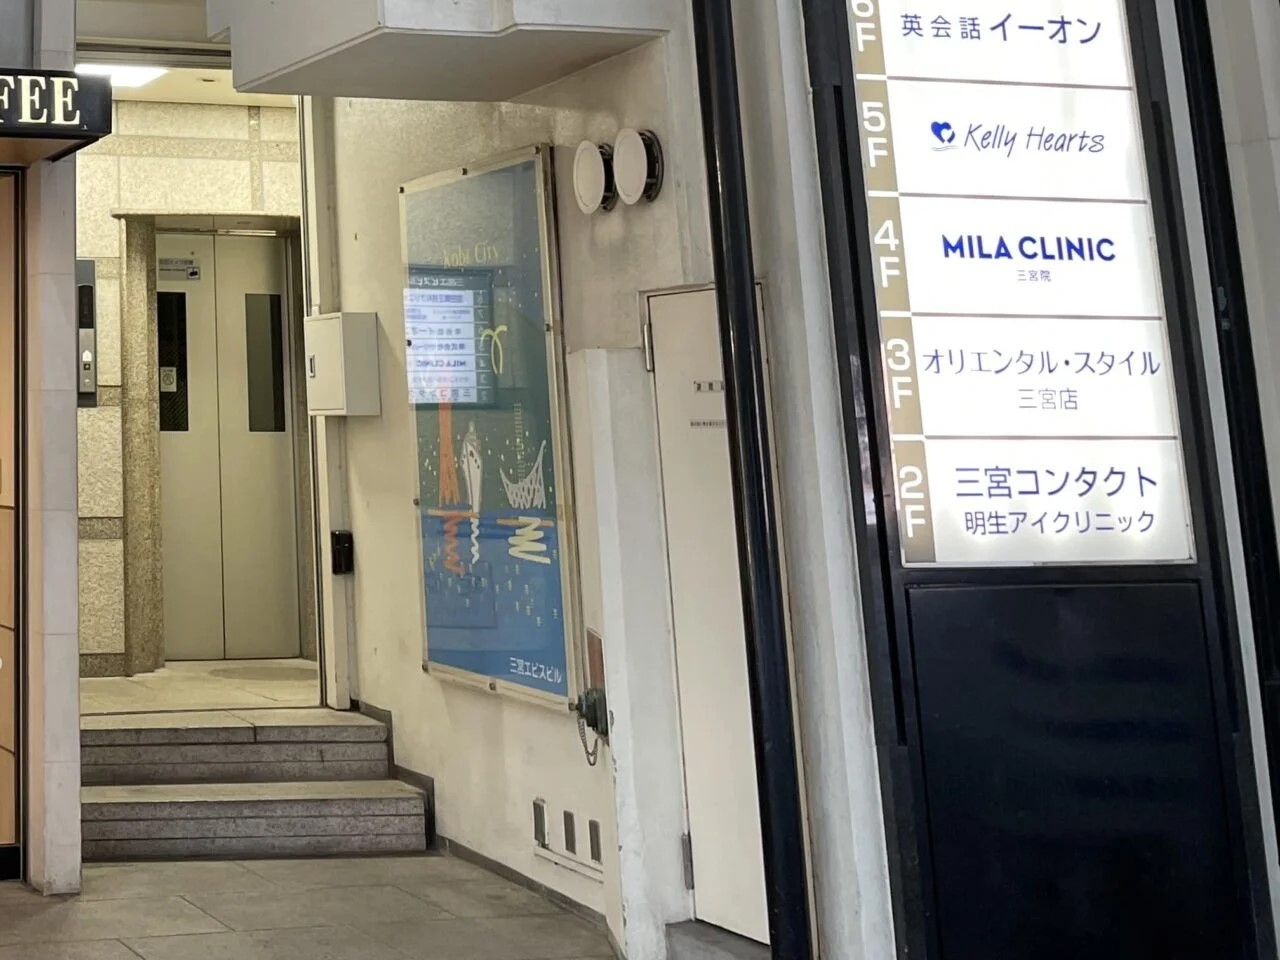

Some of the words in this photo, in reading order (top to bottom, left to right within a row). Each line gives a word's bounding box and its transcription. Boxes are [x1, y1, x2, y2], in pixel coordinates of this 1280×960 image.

[964, 123, 1017, 158] Kelly
[1026, 126, 1105, 153] Hearts
[942, 234, 1013, 260] MILA
[1018, 236, 1116, 261] CLINIC
[1017, 270, 1052, 282] 三宮院
[922, 349, 1161, 376] オリエンタル・スタイル
[1018, 388, 1078, 410] 三宮店
[955, 466, 1157, 498] 三宮コンタクト
[964, 510, 1155, 535] 明生アイクリニック
[509, 656, 562, 683] 三宮エビスビル
